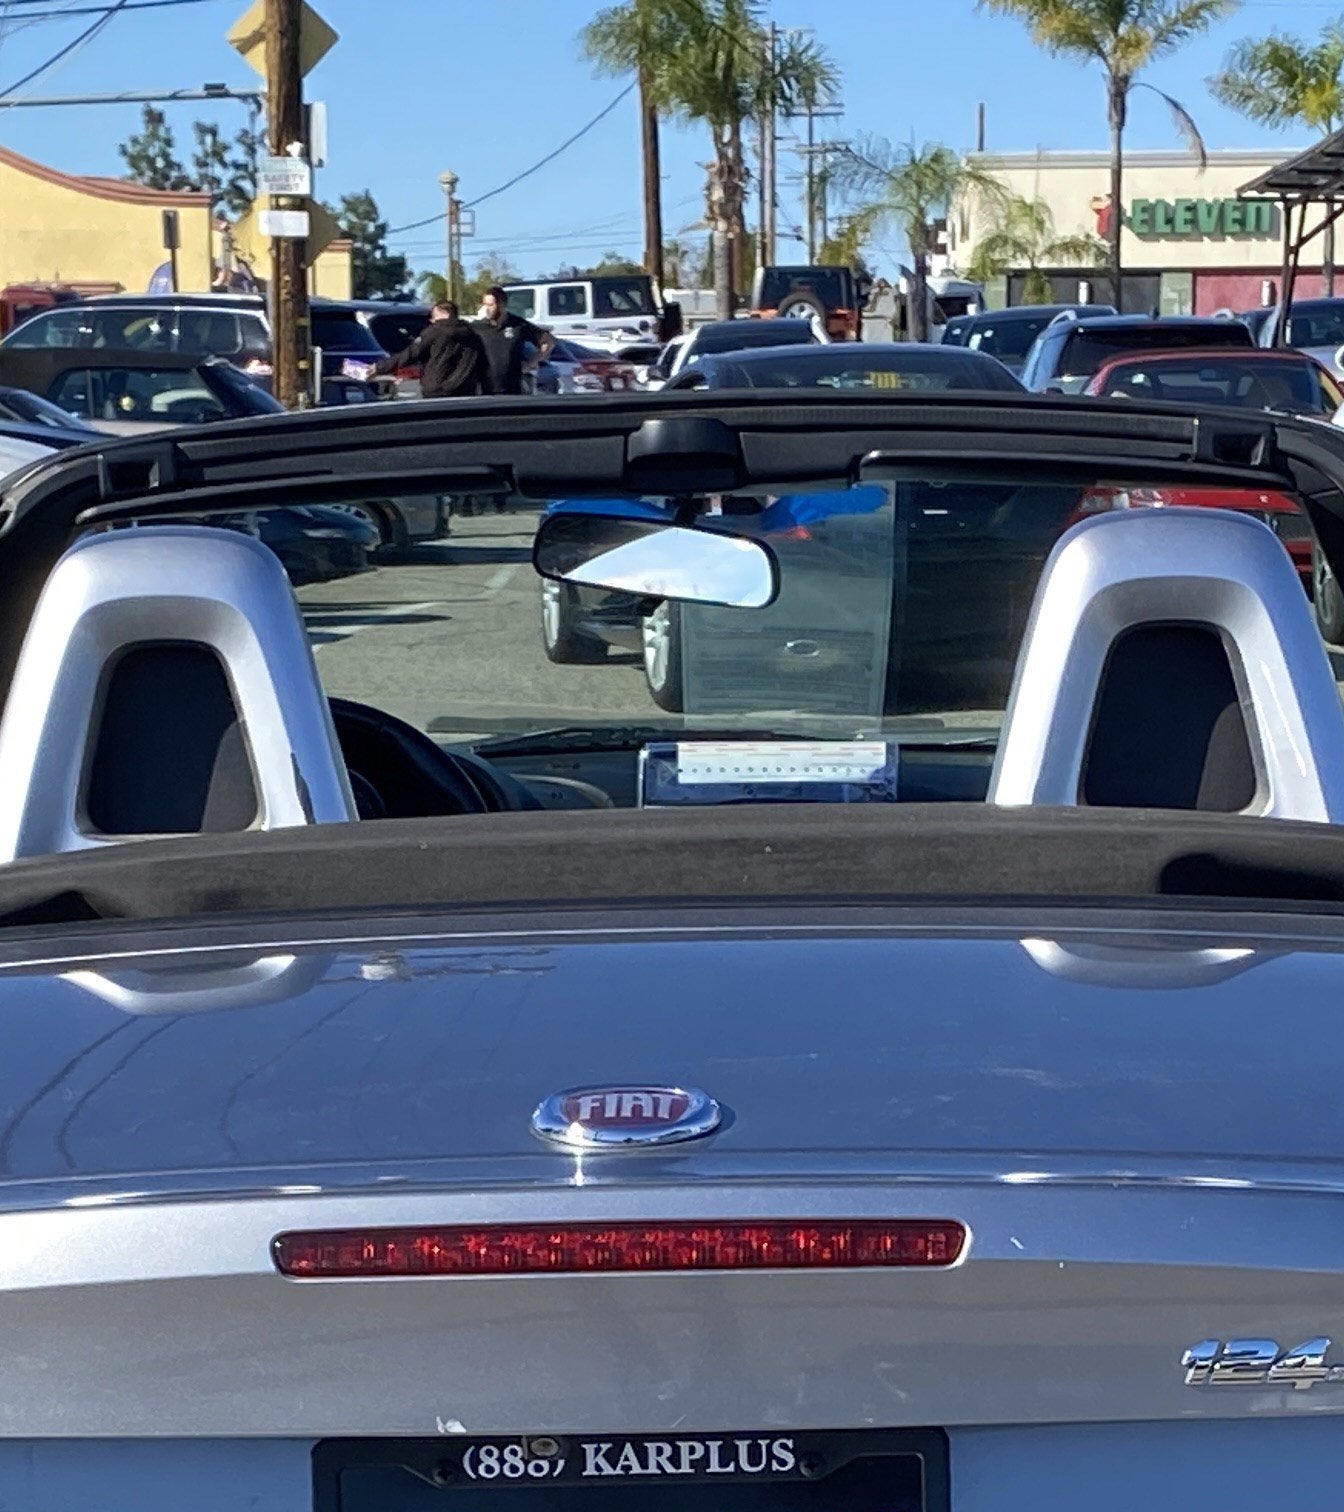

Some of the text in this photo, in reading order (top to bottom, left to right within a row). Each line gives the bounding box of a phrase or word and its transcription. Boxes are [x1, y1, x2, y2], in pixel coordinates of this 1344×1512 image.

[577, 1093, 678, 1120] FIAT
[1181, 1337, 1331, 1389] 124
[582, 1438, 796, 1476] KARPLUS
